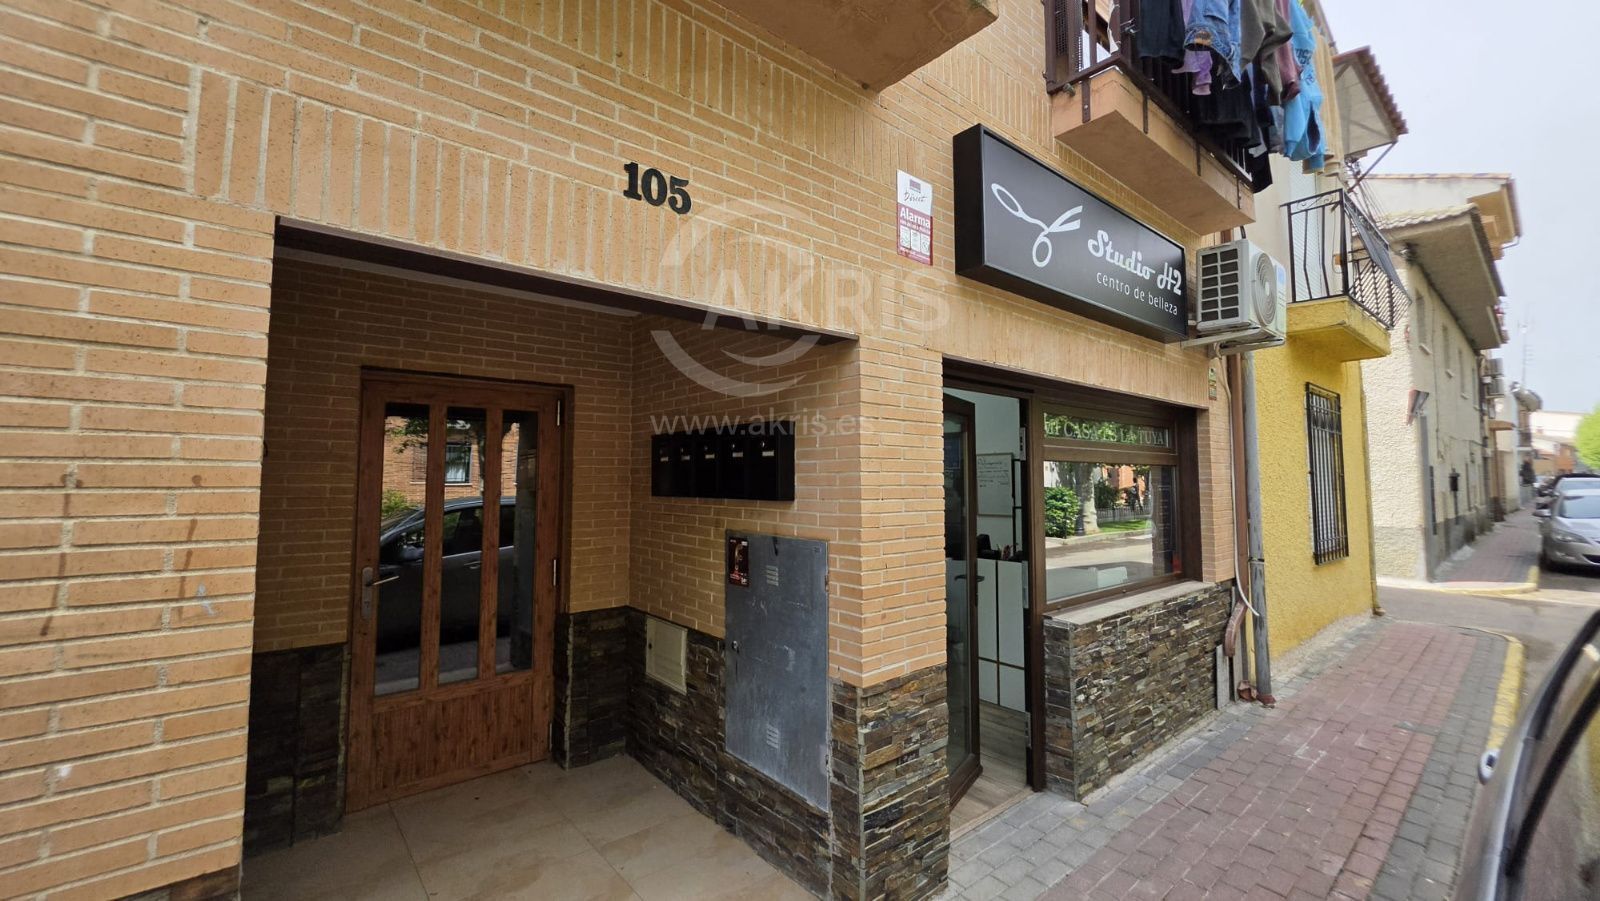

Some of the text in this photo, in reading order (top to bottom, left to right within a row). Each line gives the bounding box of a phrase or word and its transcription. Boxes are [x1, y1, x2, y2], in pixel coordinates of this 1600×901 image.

[623, 161, 692, 215] 105
[900, 207, 930, 227] Alarma
[1087, 230, 1182, 296] Studio H2
[1096, 271, 1178, 315] centro de belleza
